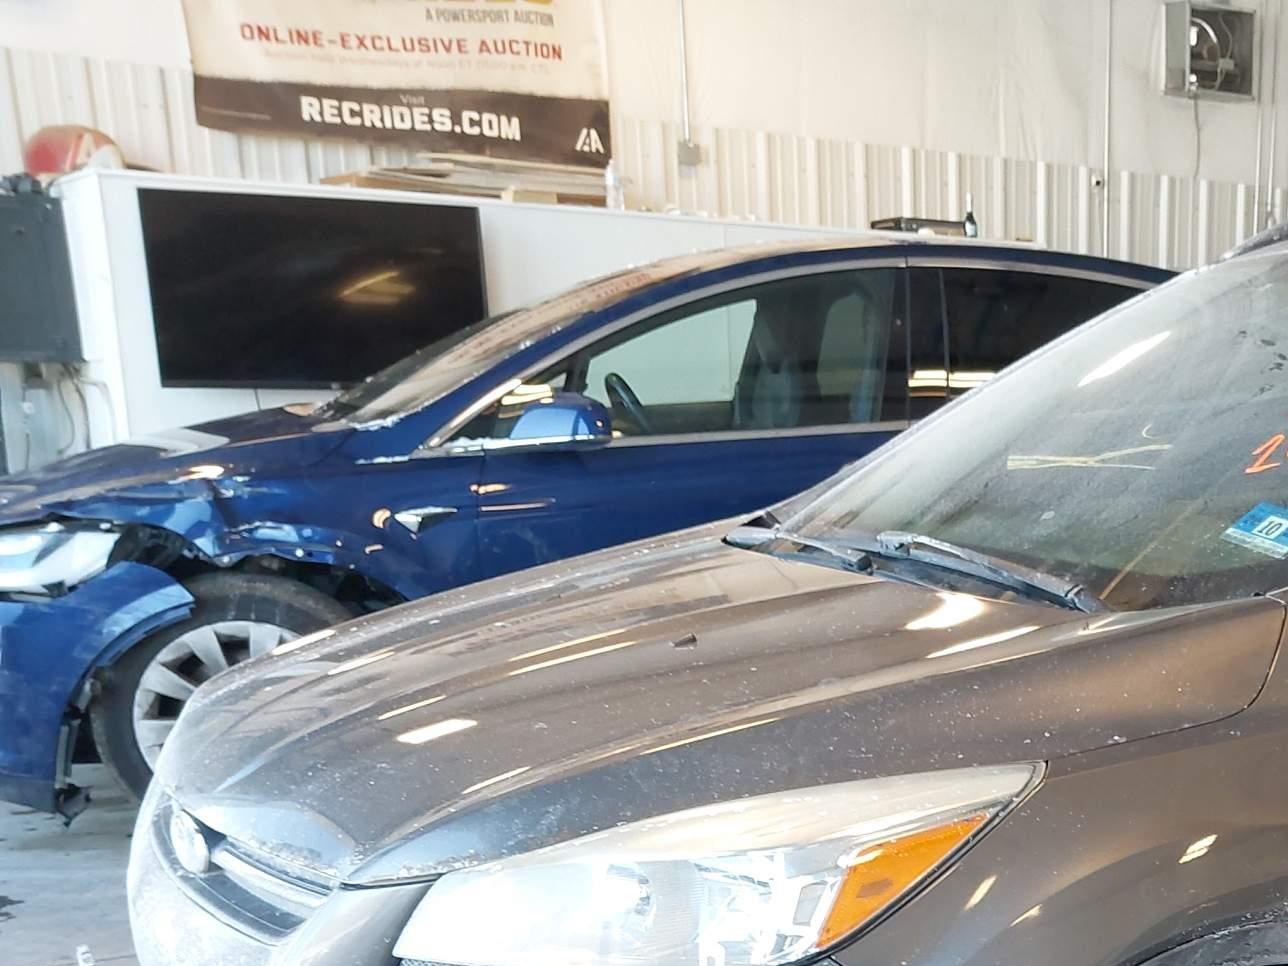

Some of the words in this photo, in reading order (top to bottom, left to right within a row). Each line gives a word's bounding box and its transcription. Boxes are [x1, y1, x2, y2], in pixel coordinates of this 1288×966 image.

[426, 7, 434, 22] A
[436, 7, 510, 24] POWERSPORT
[514, 10, 555, 26] AUCTION
[240, 23, 469, 55] ONLINE-EXCLUSIVE
[478, 38, 563, 61] AUCTION
[300, 96, 521, 142] RECRIDES.COM
[1256, 520, 1283, 536] 10
